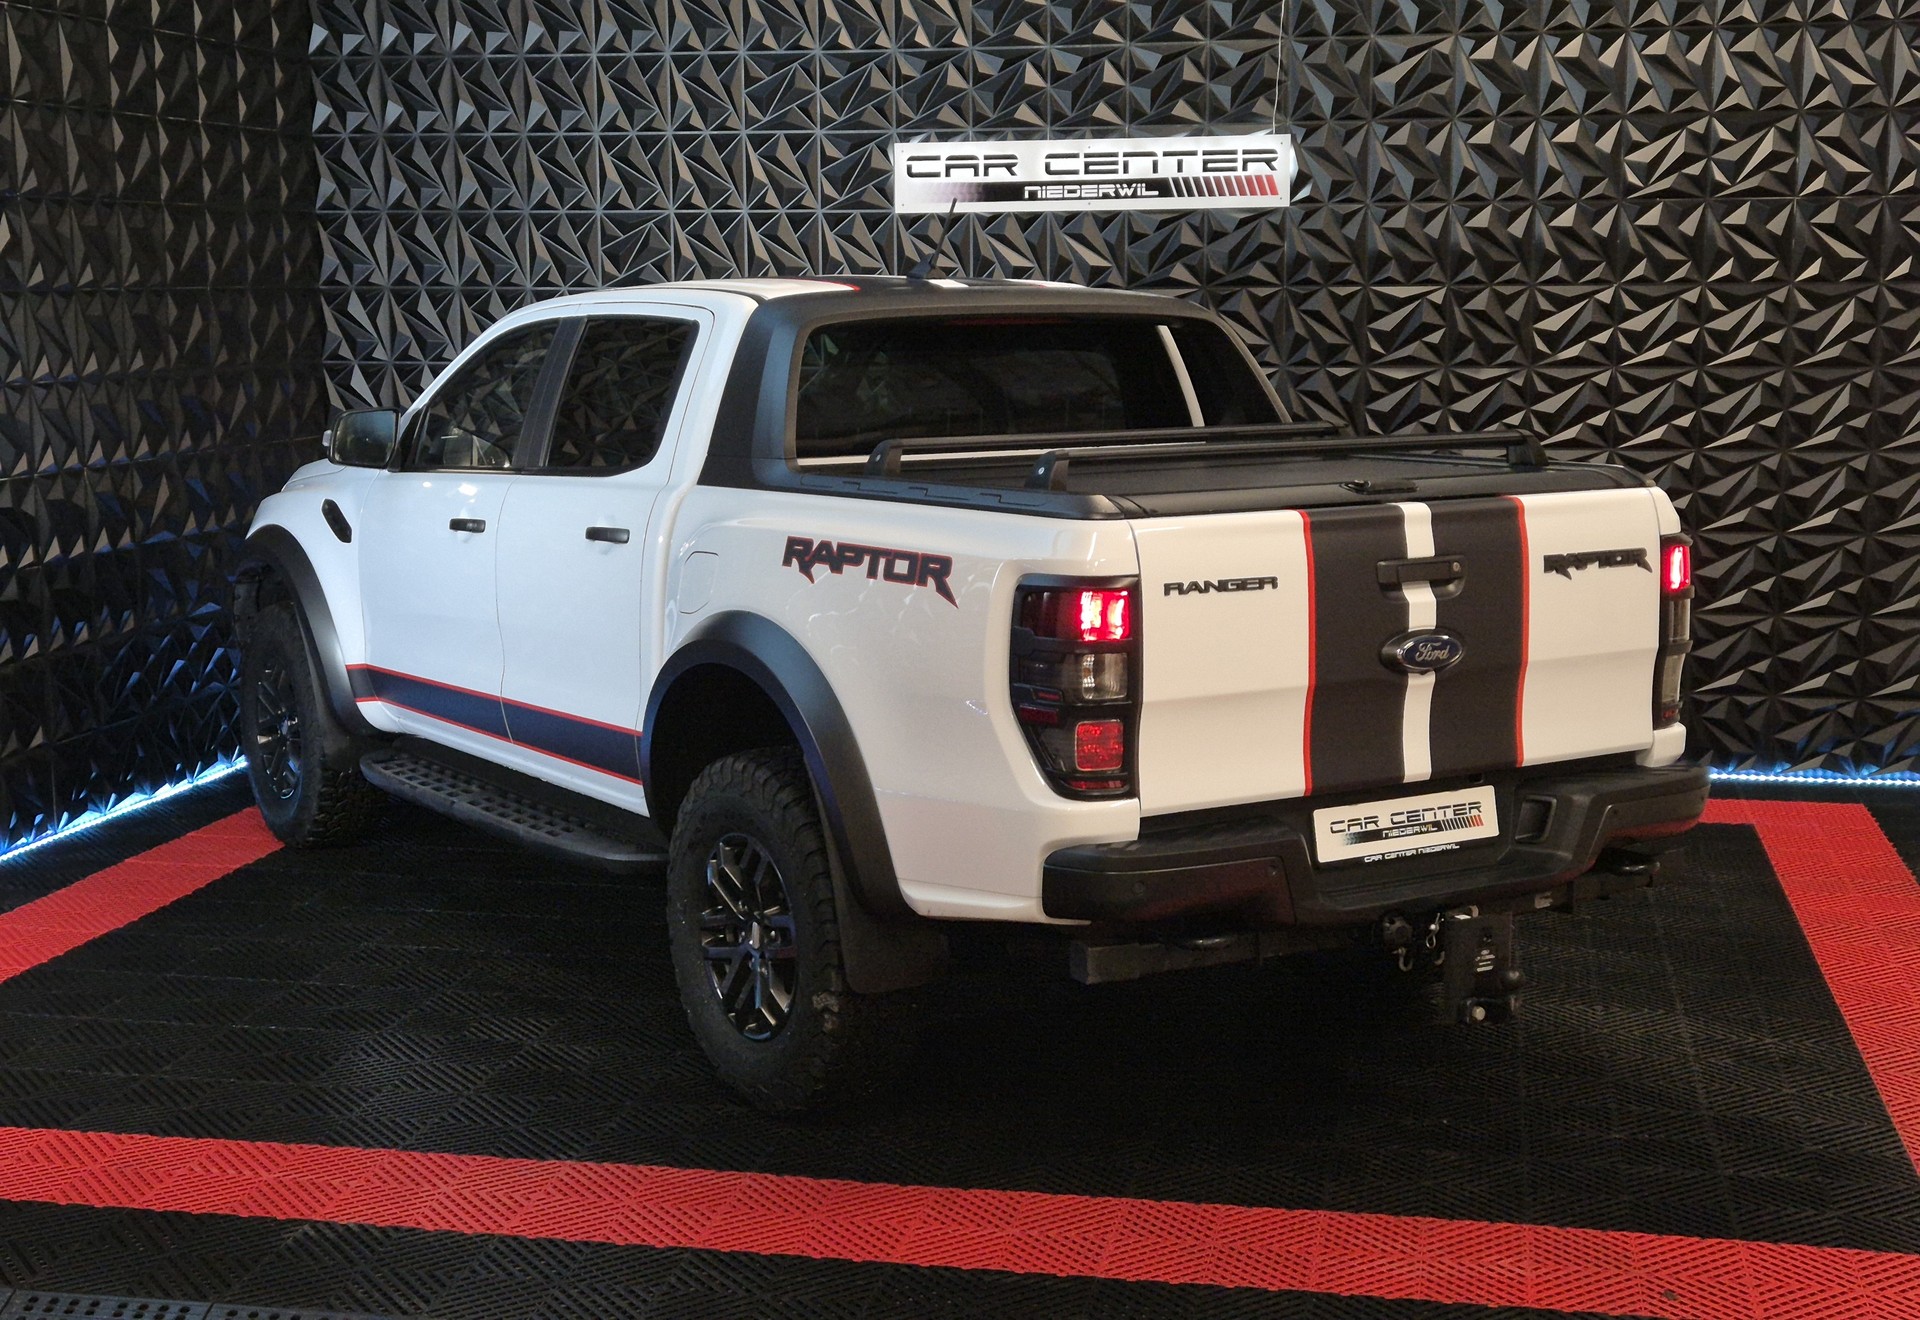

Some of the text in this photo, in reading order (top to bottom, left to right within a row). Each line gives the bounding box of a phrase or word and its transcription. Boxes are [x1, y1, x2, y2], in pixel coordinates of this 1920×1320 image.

[906, 148, 1279, 178] CAR CENTER
[1024, 182, 1159, 199] NIEDERWIL
[782, 535, 959, 609] RAPTOR
[1543, 547, 1653, 580] RAPTOR
[1163, 576, 1278, 597] RANGER
[1415, 642, 1450, 662] Ford
[1330, 801, 1482, 834] CAR CENTER
[1382, 823, 1438, 838] NIEDERWIL
[1364, 854, 1383, 863] CAR
[1384, 849, 1417, 860] CENTER
